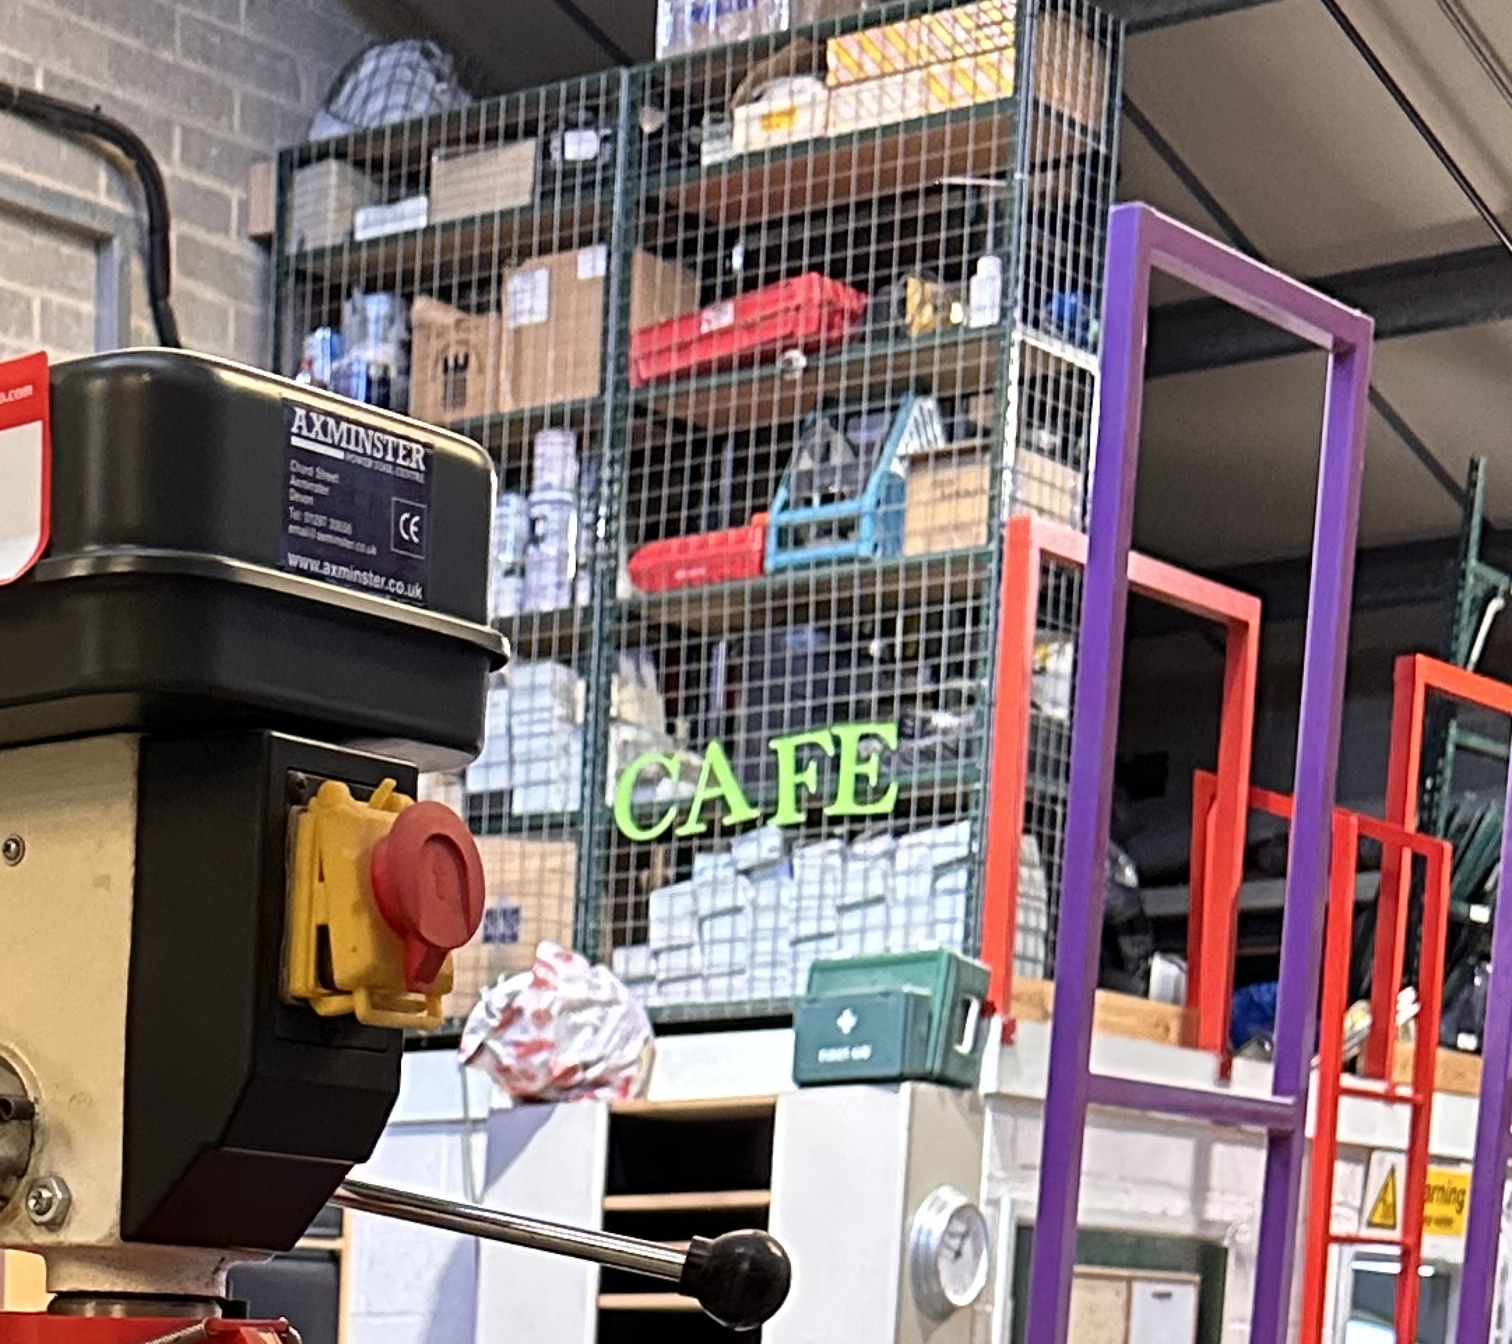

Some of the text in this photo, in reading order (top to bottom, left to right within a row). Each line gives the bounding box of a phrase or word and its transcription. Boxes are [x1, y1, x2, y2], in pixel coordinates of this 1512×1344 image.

[291, 407, 426, 471] AXMINSTER
[288, 551, 423, 600] www.axminster.co.uk
[612, 721, 900, 843] CAFE
[1424, 1180, 1466, 1216] arning
